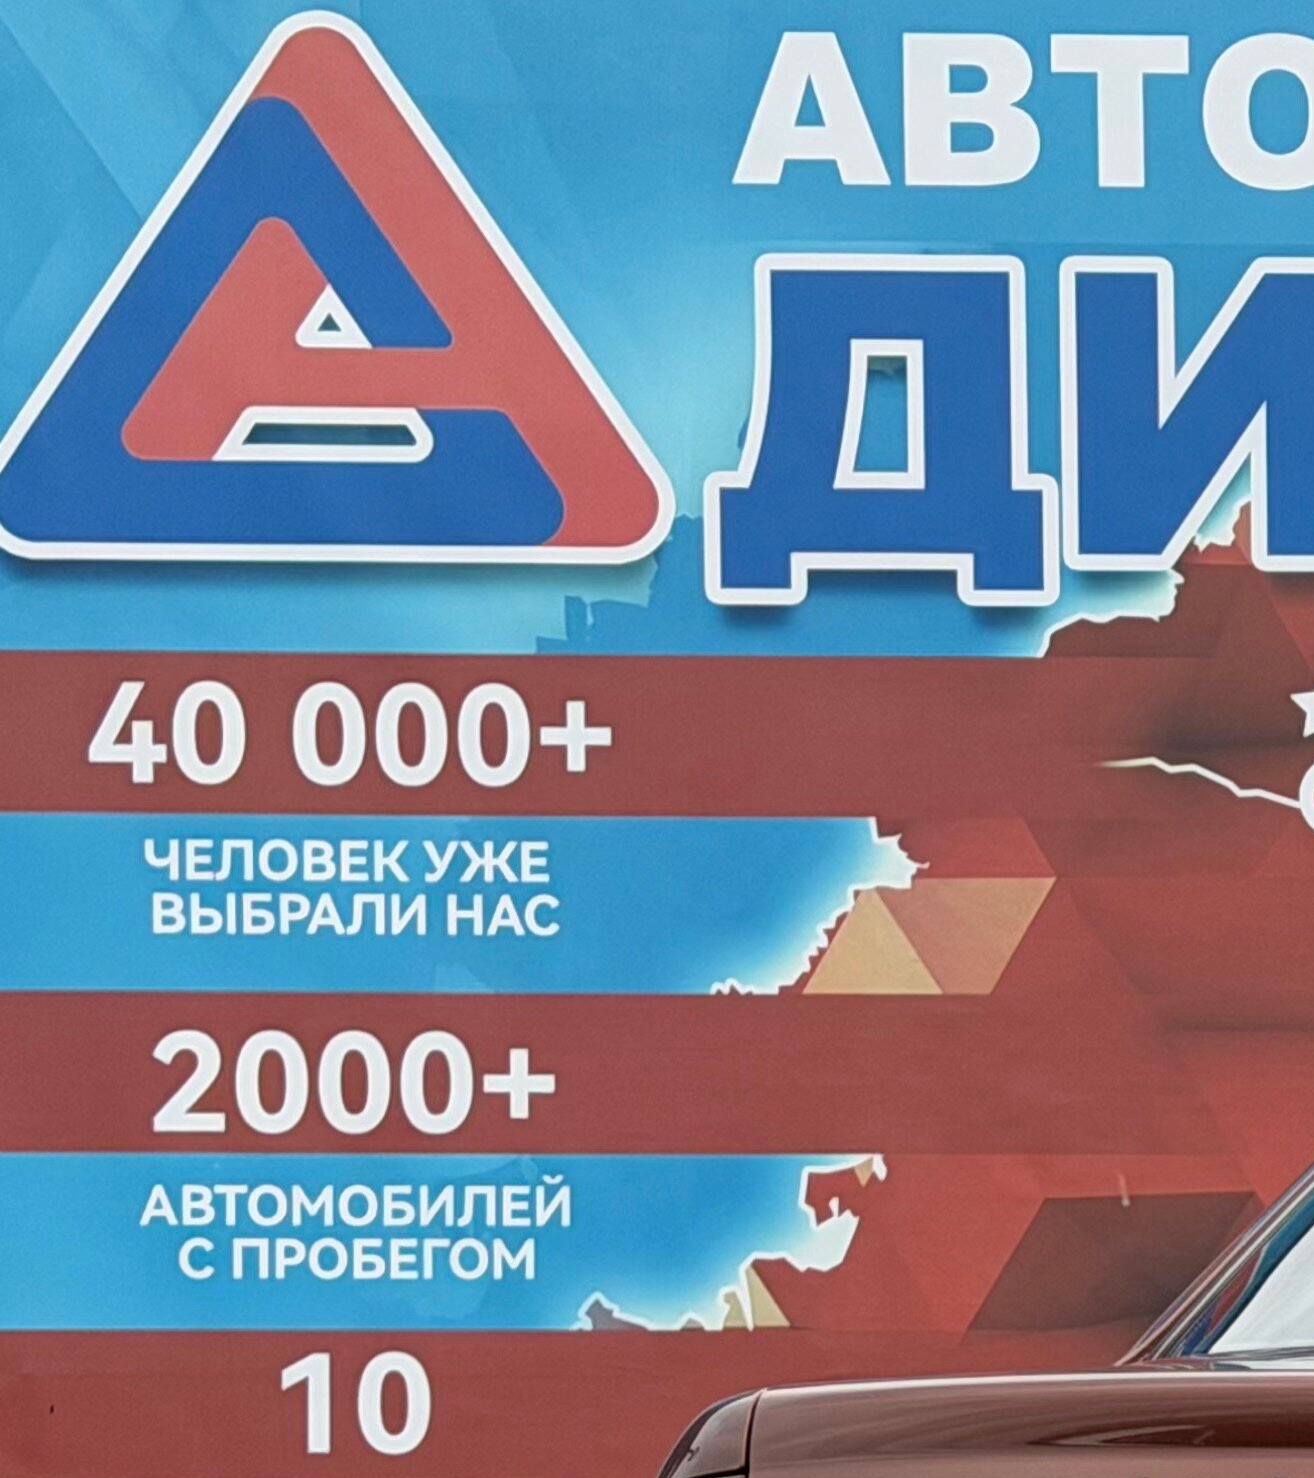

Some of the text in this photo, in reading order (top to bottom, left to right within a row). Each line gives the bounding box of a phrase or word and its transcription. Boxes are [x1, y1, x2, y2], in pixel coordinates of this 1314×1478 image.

[88, 680, 612, 788] 40 000+
[143, 838, 551, 883] ЧЕЛОВЕК УЖЕ
[151, 892, 560, 937] ВЫБРАЛИ НАС
[152, 1029, 556, 1135] 2000+
[139, 1174, 572, 1228] АВТОМОБИЛЕЙ
[178, 1237, 536, 1280] С ПРОБЕГОМ
[281, 1351, 431, 1455] 10
